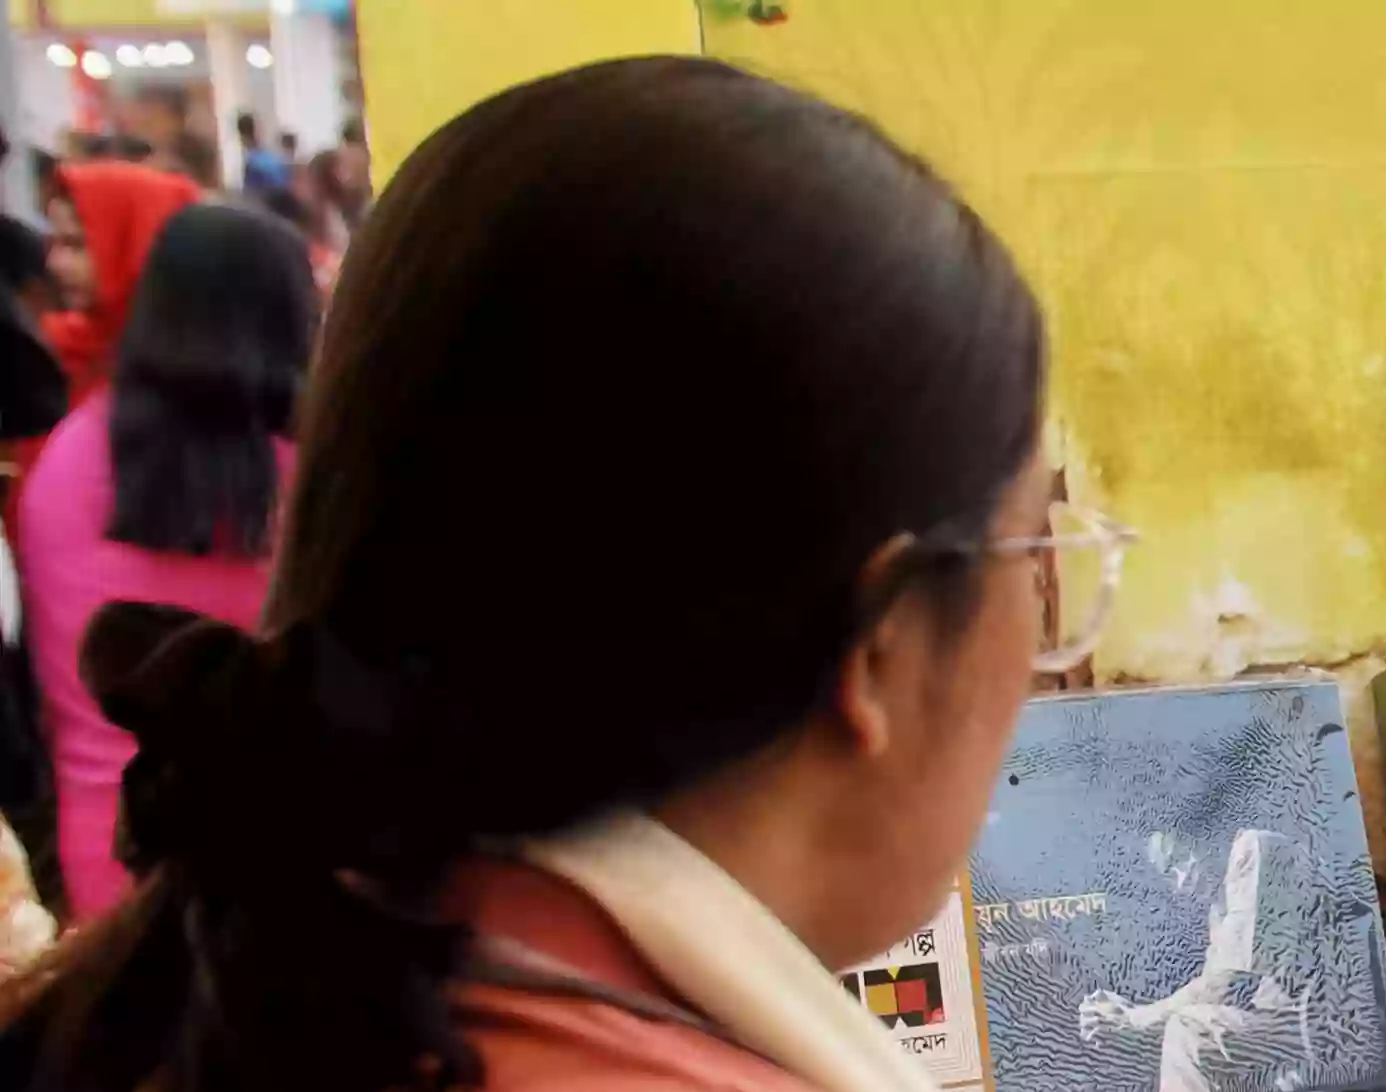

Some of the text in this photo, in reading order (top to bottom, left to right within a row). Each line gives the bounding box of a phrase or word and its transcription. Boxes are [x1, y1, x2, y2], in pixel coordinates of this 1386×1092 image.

[973, 891, 1108, 934] য়ূন আহমেদ
[900, 1032, 947, 1054] হমেদ
